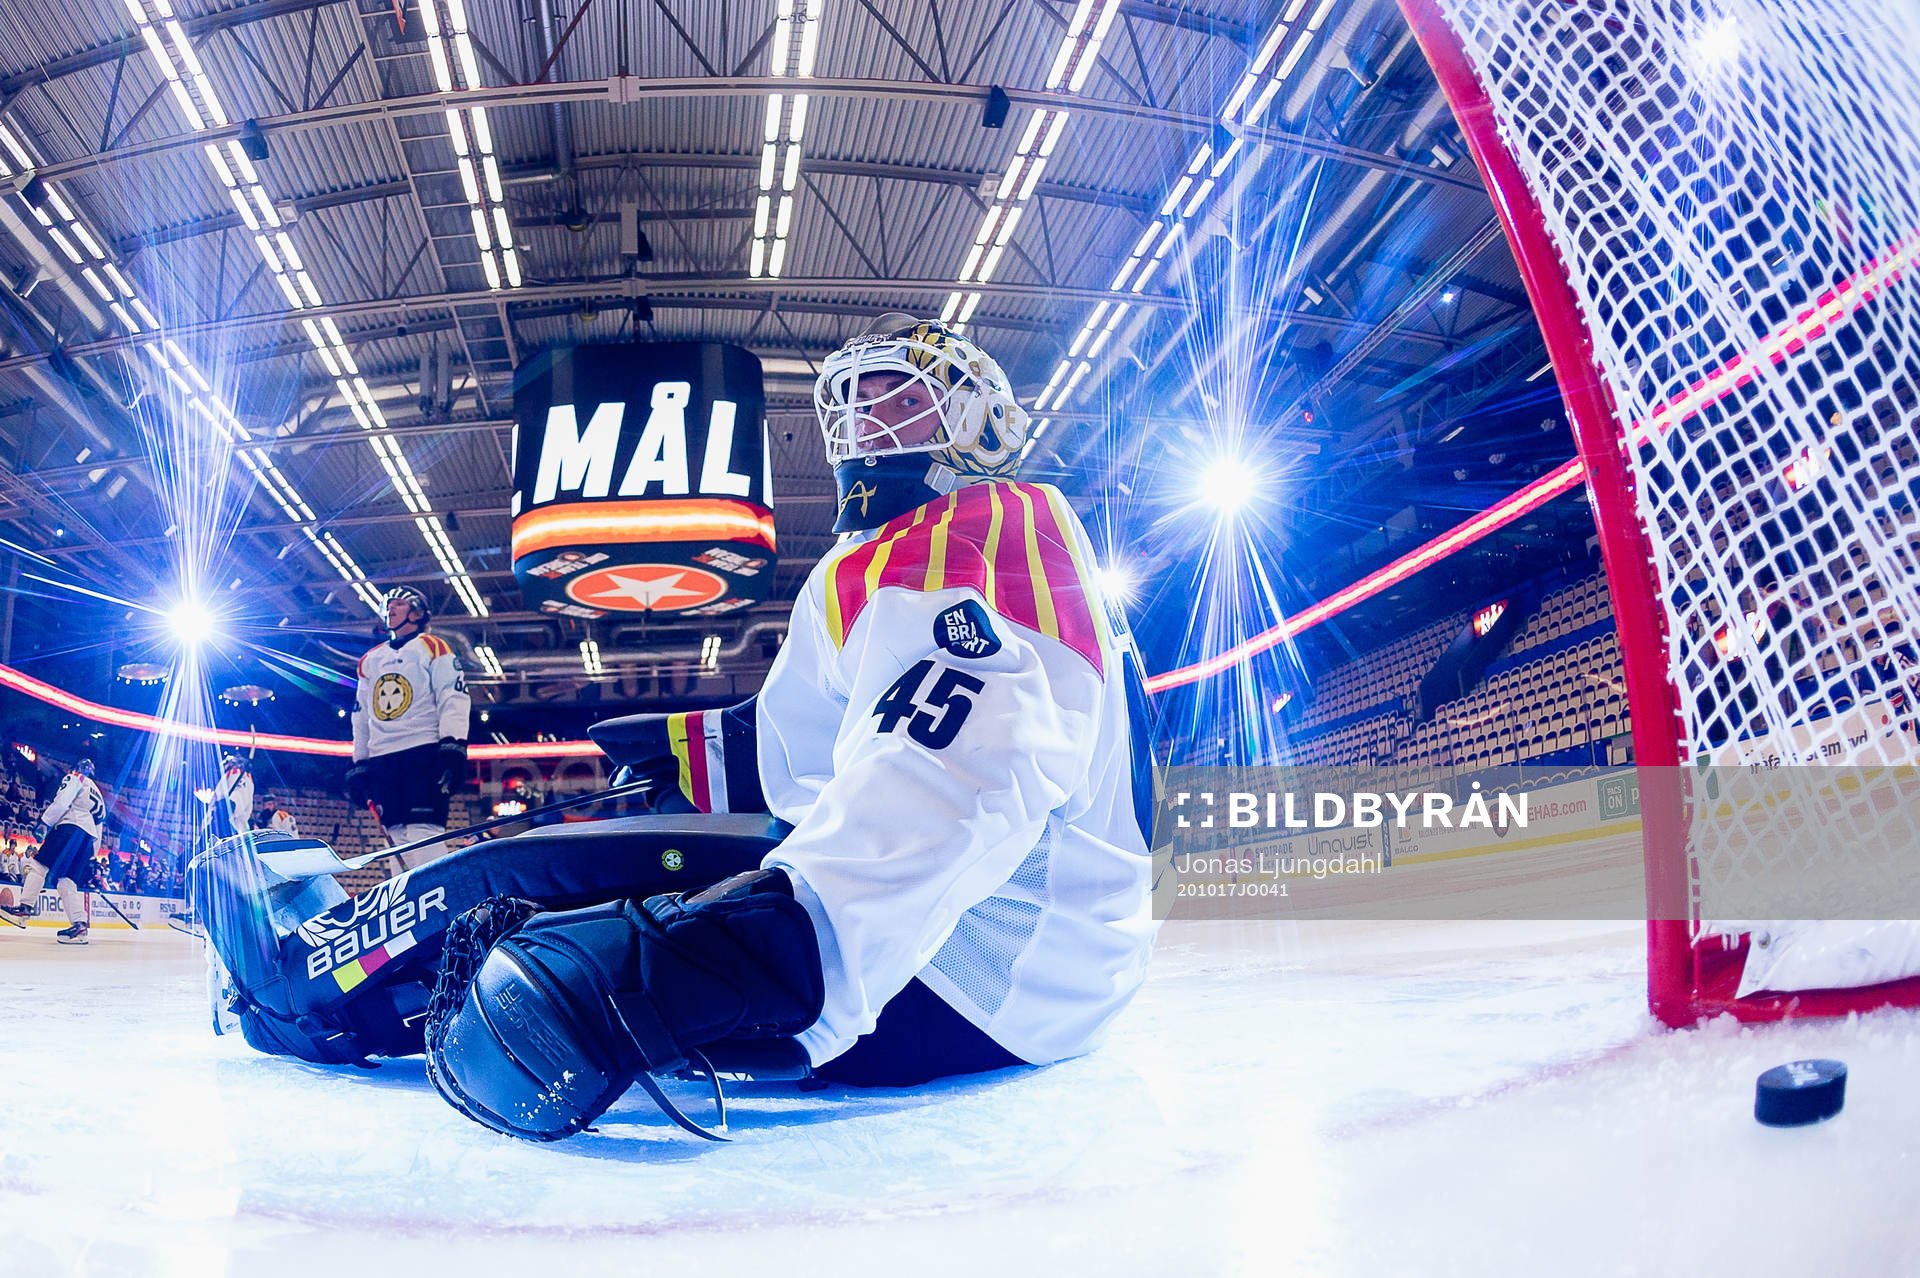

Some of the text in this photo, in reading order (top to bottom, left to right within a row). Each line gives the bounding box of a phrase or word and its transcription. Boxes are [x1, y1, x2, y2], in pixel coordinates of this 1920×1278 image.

[533, 381, 751, 505] MÅL
[944, 608, 967, 625] EN
[871, 659, 986, 750] 45
[1607, 793, 1623, 810] ON
[1395, 845, 1419, 855] BALCO
